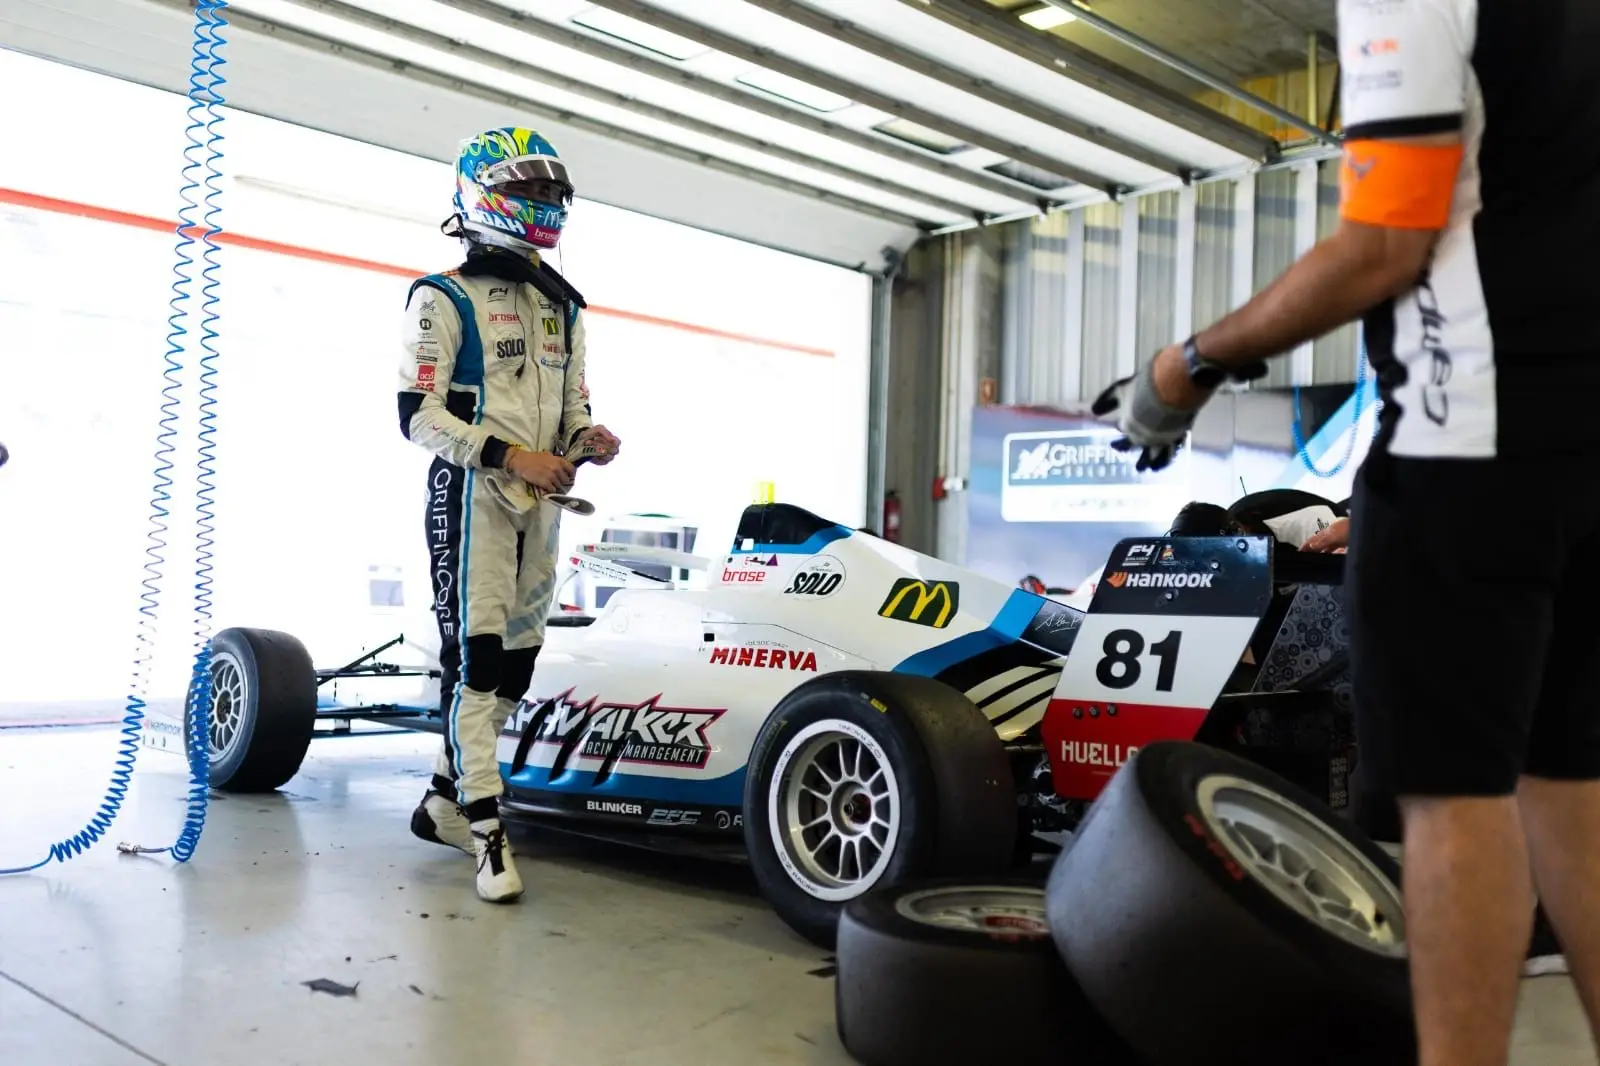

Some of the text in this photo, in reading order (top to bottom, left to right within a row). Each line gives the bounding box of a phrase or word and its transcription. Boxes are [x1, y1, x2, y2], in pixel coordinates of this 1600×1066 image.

[488, 311, 520, 323] brose
[496, 338, 525, 359] SOLO
[1414, 284, 1452, 427] Camp
[1127, 544, 1156, 557] F4
[722, 567, 766, 582] brose
[784, 571, 843, 596] SOLO
[709, 646, 818, 672] MINERVA
[1096, 628, 1183, 692] 81
[624, 744, 704, 764] MANAGEMENT
[586, 800, 642, 815] BLINKER
